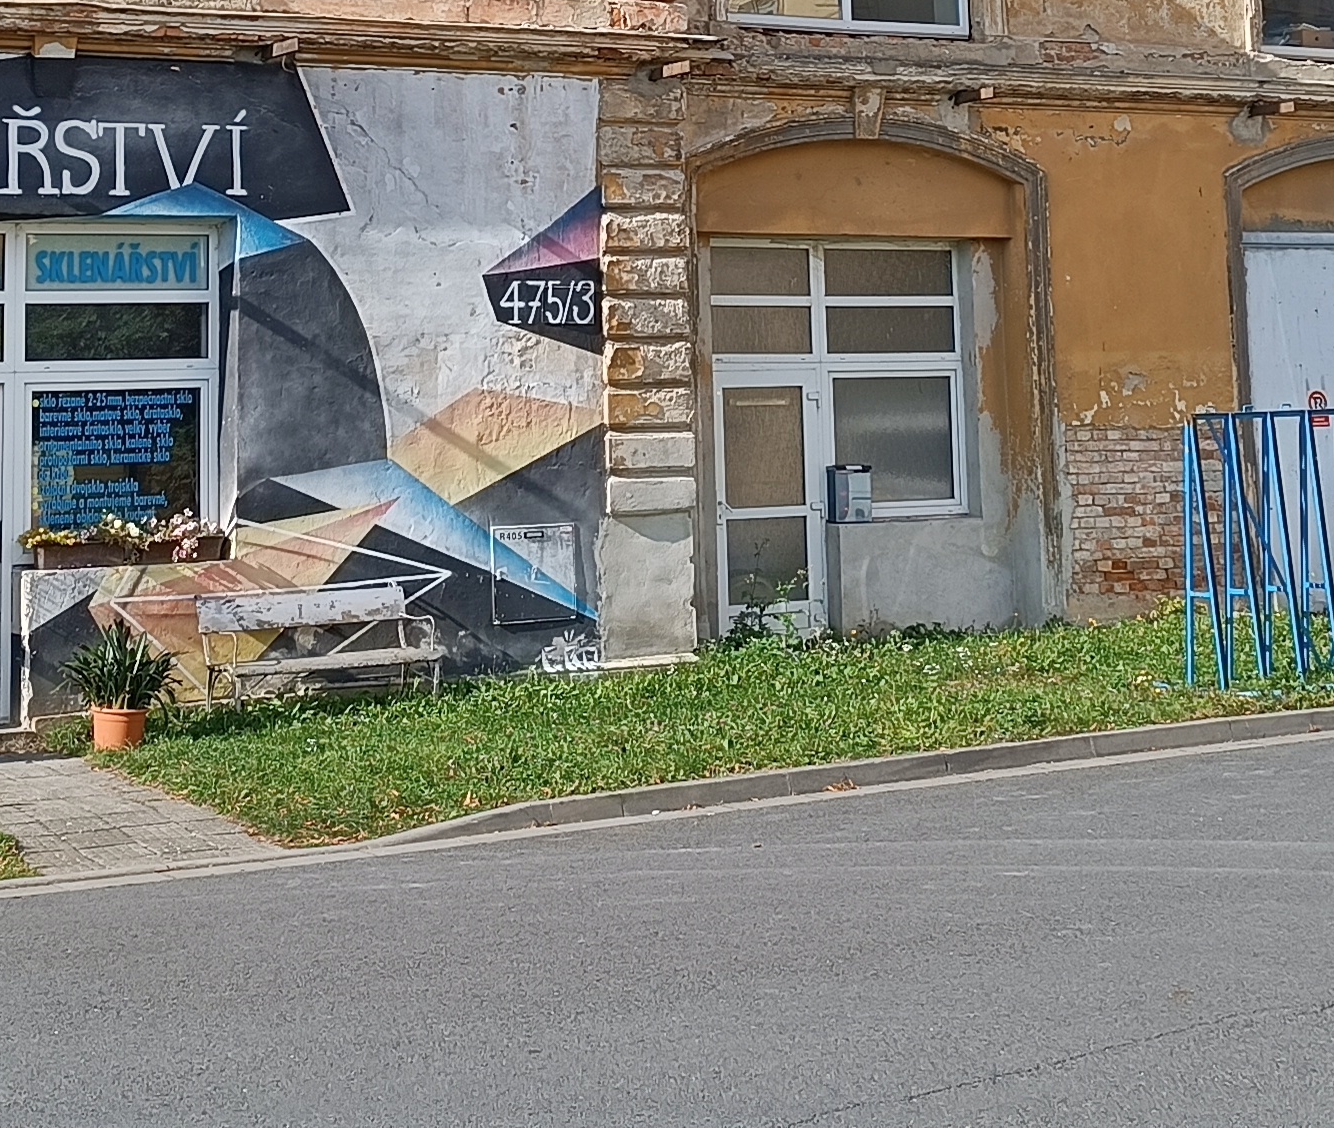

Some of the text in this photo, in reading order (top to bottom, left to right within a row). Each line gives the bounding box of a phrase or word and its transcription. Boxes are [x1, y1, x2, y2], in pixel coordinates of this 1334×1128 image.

[35, 241, 199, 284] SKLENÁŘSTVÍ
[499, 280, 595, 325] 475/3
[39, 393, 57, 408] sklo
[125, 391, 175, 409] bezpečnostní
[176, 389, 193, 404] sklo
[39, 407, 72, 422] barevné
[123, 405, 142, 421] sklo,
[124, 419, 146, 437] velký
[148, 419, 171, 437] výběr
[104, 435, 125, 451] skla,
[125, 433, 152, 449] kalené
[156, 433, 174, 447] sklo
[90, 450, 110, 466] sklo,
[110, 448, 152, 464] keramické
[153, 447, 170, 463] sklo
[78, 499, 85, 509] a
[87, 494, 132, 511] montujeme
[134, 490, 168, 508] barevné,
